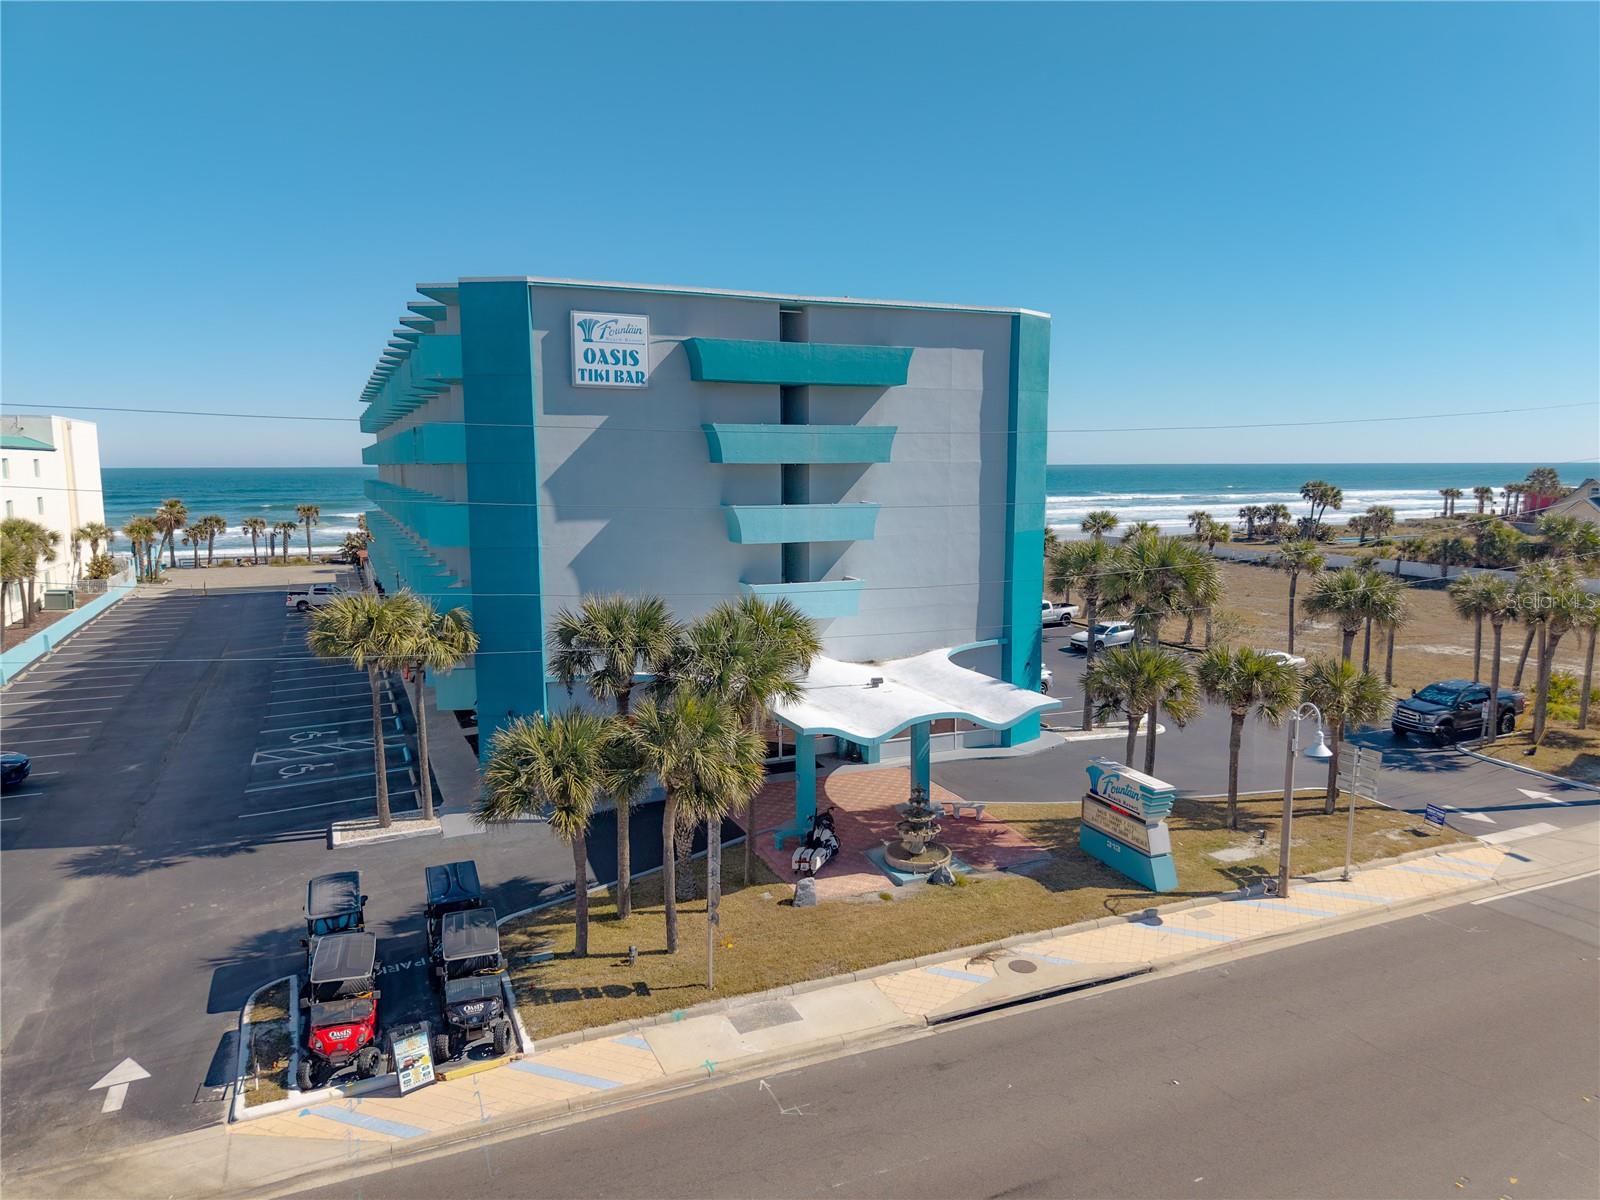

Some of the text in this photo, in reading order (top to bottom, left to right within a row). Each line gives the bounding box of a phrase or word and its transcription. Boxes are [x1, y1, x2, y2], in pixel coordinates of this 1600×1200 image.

[597, 319, 642, 340] Fountain
[583, 347, 640, 367] OASIS
[577, 368, 646, 385] TIKI BAR
[1101, 773, 1140, 801] Fountain
